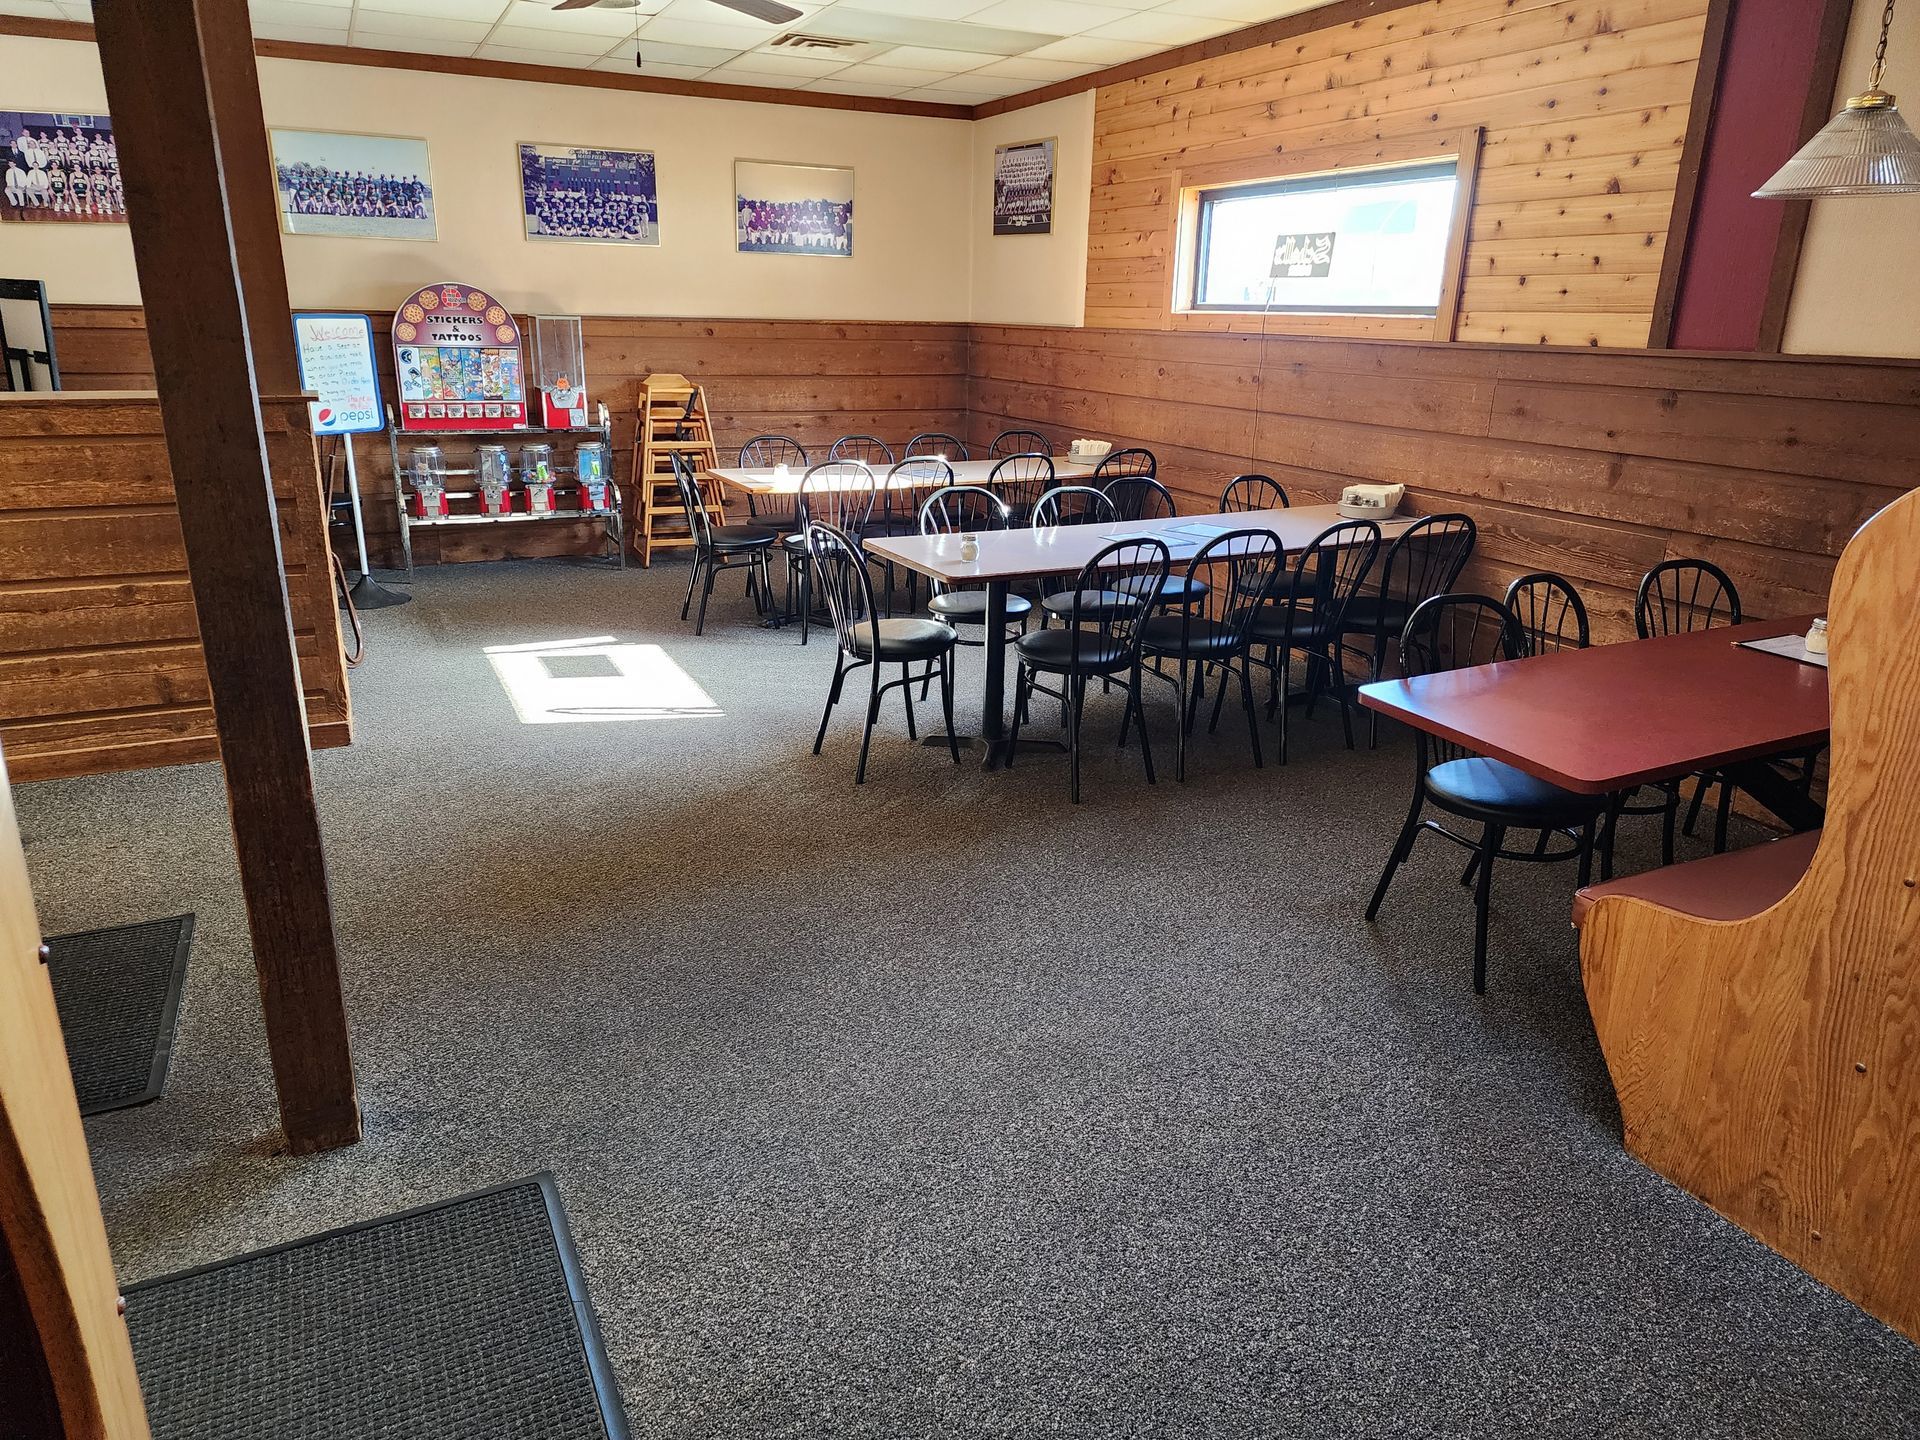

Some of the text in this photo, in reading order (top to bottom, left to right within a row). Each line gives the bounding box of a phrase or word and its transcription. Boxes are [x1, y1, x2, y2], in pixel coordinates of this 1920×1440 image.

[426, 315, 483, 325] STICKERS
[310, 326, 365, 341] Welcome
[452, 325, 460, 333] &
[432, 333, 482, 342] TATTOOS
[340, 408, 374, 424] pepsi
